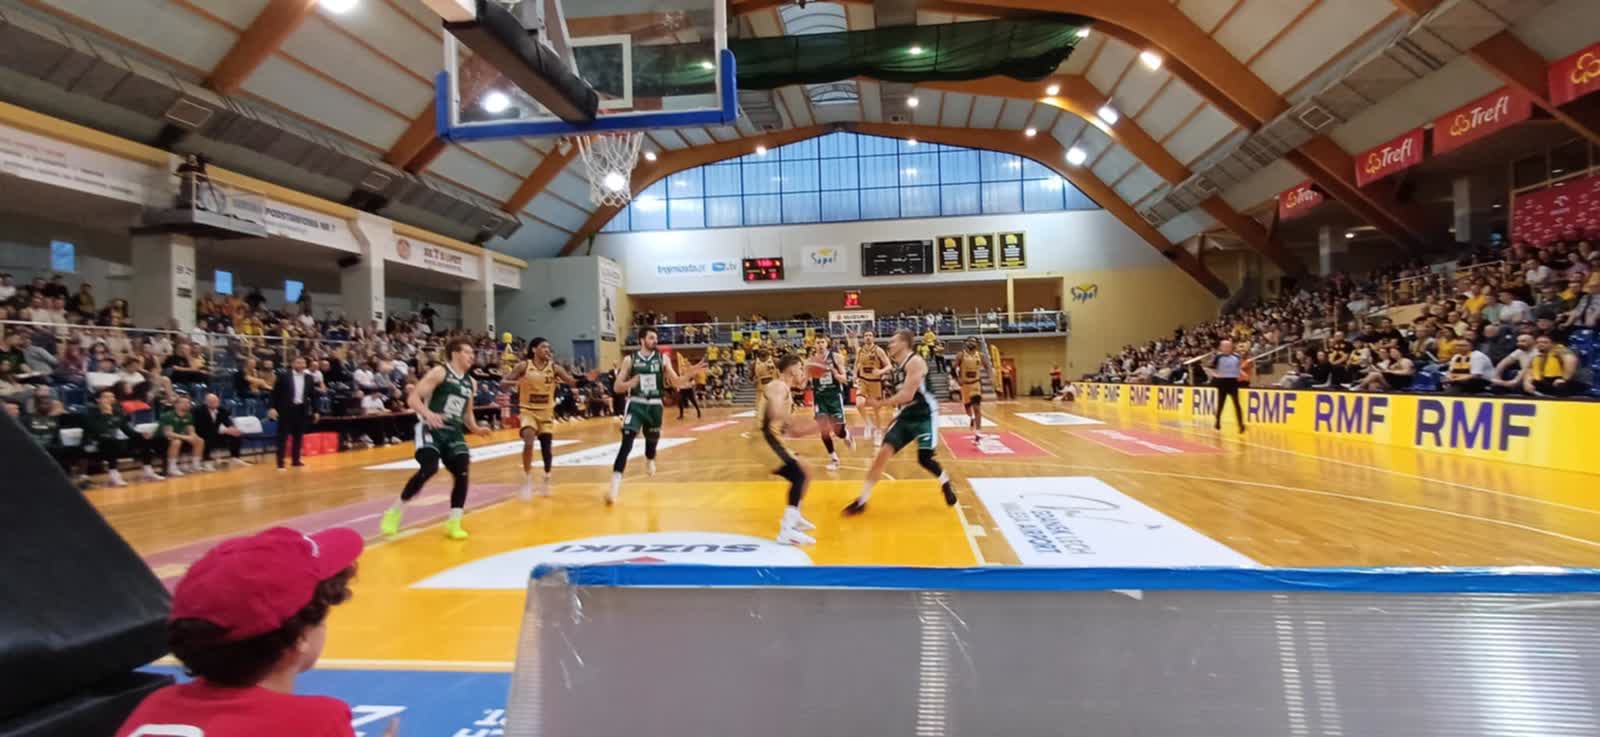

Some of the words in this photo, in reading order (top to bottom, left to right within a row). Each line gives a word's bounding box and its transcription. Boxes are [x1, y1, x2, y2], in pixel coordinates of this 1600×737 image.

[1471, 96, 1509, 128] Trefl
[1381, 138, 1413, 168] Trefl
[1104, 385, 1120, 402] RMF
[1130, 386, 1150, 406] RMF
[1158, 388, 1184, 411] RMF
[1192, 389, 1217, 416] RM
[1247, 391, 1297, 424] RMF
[1314, 394, 1389, 434] RMF
[1415, 399, 1537, 451] RMF
[552, 543, 761, 554] SUZUKI
